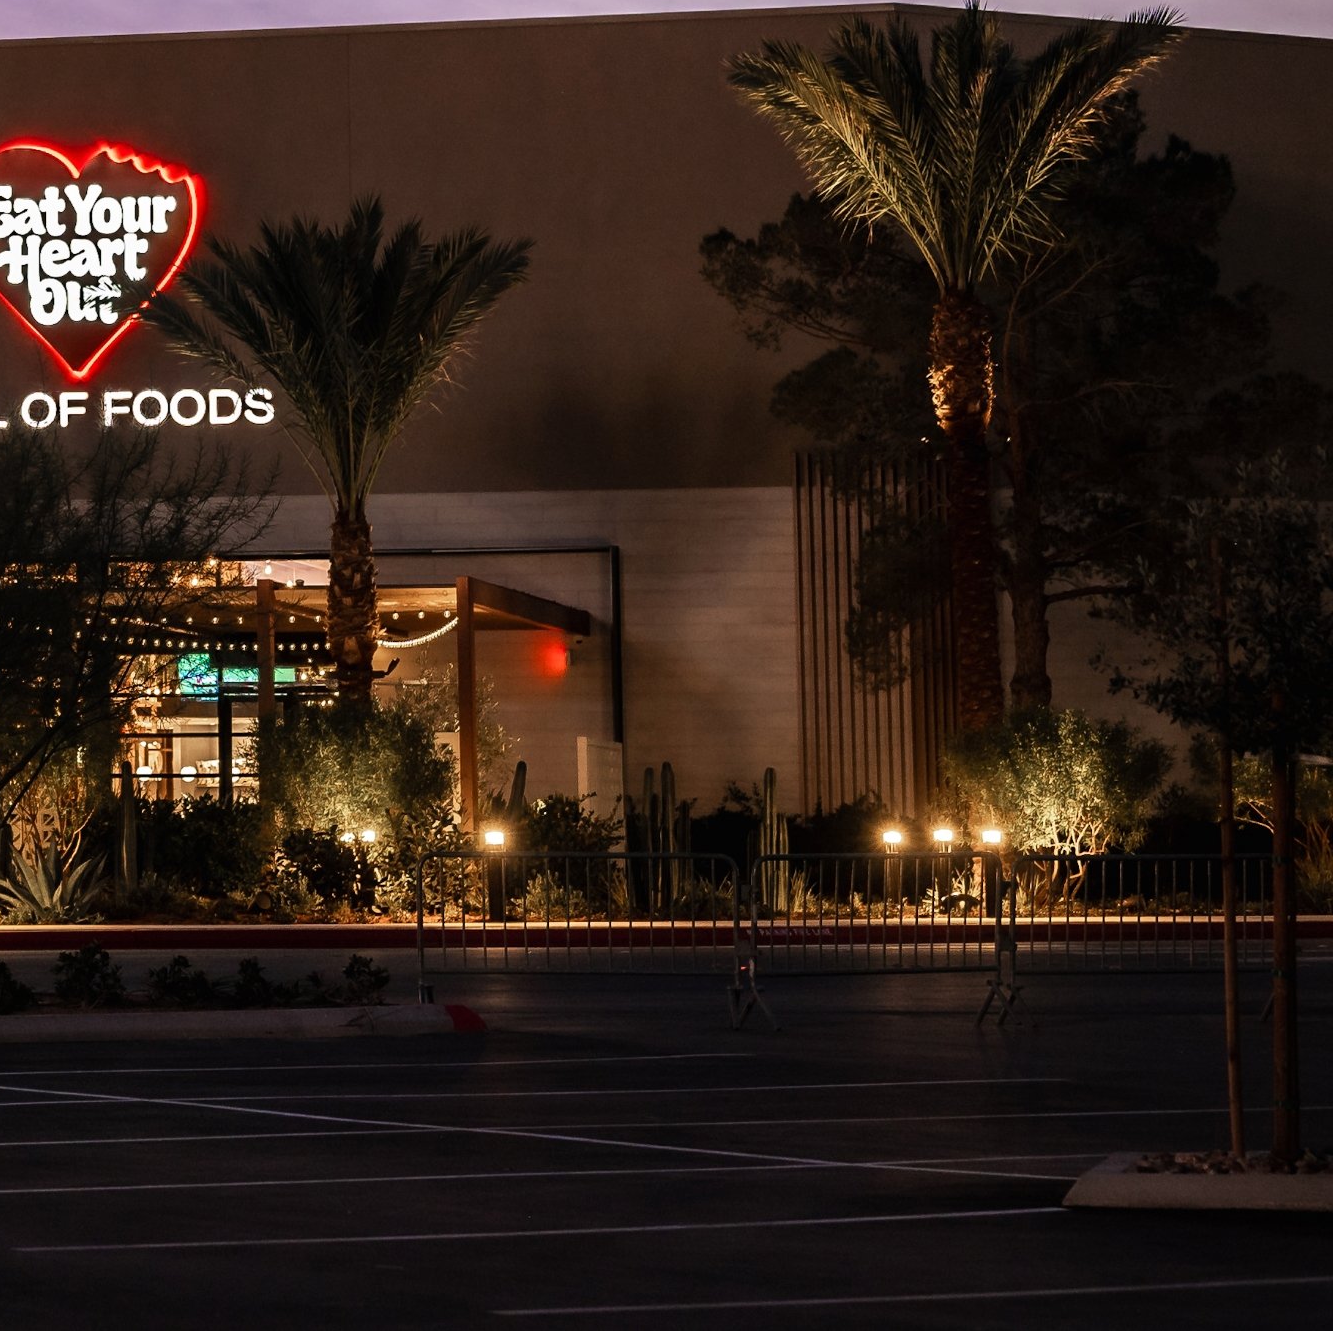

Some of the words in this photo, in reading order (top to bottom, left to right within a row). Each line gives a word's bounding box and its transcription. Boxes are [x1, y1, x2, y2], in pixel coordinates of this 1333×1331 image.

[64, 184, 177, 236] Your
[29, 276, 121, 326] Out
[20, 390, 89, 428] OF
[102, 388, 276, 427] FOODS
